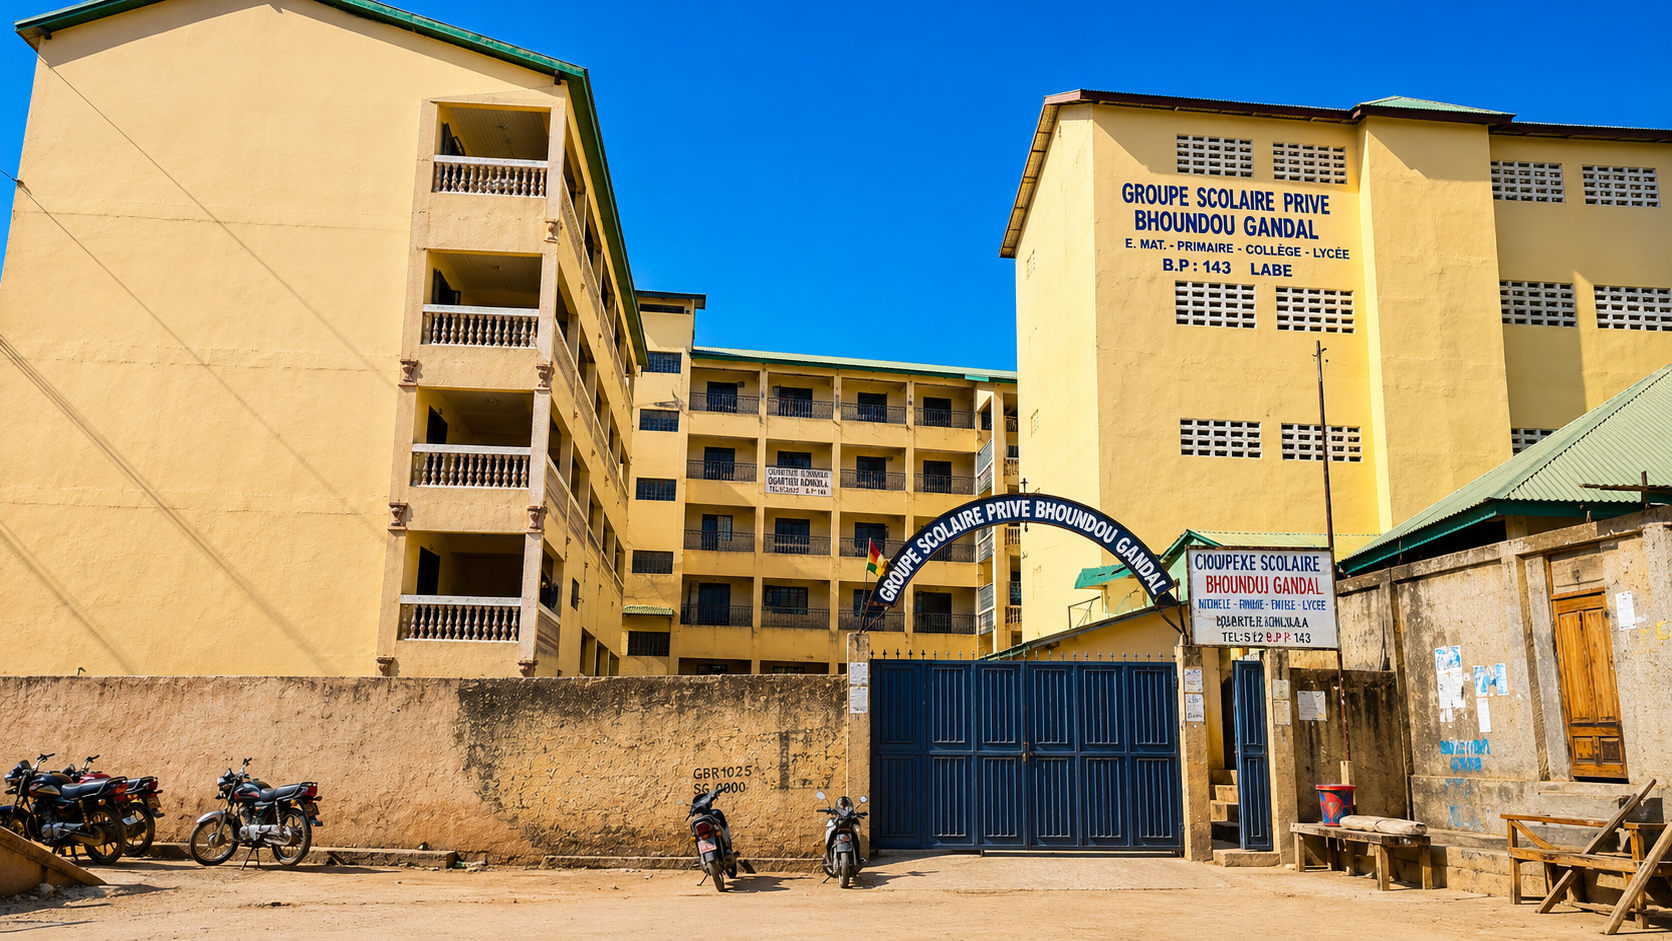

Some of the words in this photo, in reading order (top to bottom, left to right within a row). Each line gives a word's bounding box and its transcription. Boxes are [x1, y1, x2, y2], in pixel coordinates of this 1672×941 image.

[1122, 183, 1189, 206] GROUPE
[1197, 187, 1275, 211] SCOLAIRE
[1284, 192, 1330, 215] PRIVE
[1135, 210, 1235, 235] BHOUNDOU
[1244, 216, 1319, 239] GANDAL
[1125, 238, 1136, 249] E.
[1140, 239, 1166, 250] MAT.
[1177, 240, 1234, 253] PRIMAIRE
[1246, 244, 1301, 257] COLLÈGE
[1313, 247, 1350, 260] LYCÉE
[1203, 260, 1232, 274] 143
[1250, 263, 1293, 277] LABE
[879, 550, 922, 602] GROUPE
[916, 506, 985, 555] SCOLAIRE
[986, 500, 1031, 522] PRIVE
[1035, 500, 1119, 544] BHOUNDOU
[1116, 537, 1167, 595] GANDAL
[1261, 555, 1321, 572] SCOLAIRE
[1273, 576, 1324, 595] GANDAL
